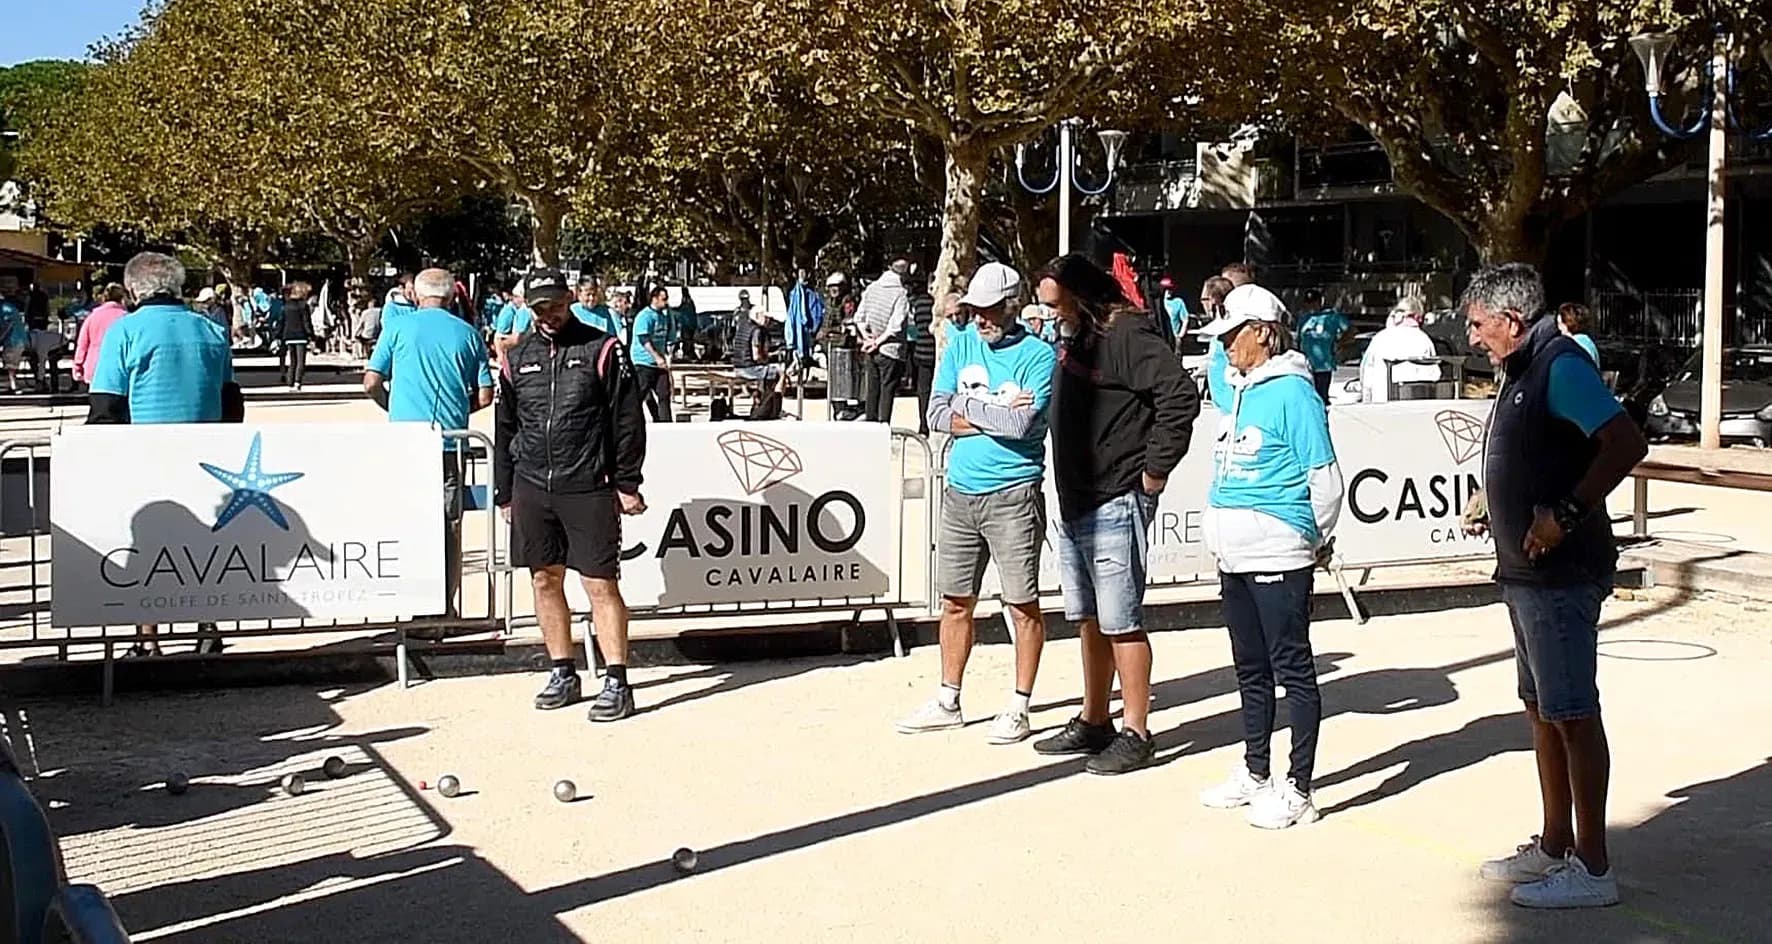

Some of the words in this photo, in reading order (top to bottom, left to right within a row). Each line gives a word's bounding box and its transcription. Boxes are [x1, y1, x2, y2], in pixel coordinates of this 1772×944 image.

[1348, 468, 1483, 524] CASI
[620, 490, 866, 562] ASINO
[100, 540, 400, 588] CAVALAIRE
[706, 563, 860, 587] CAVALAIRE
[139, 595, 200, 609] GOLFE
[206, 593, 231, 607] DE
